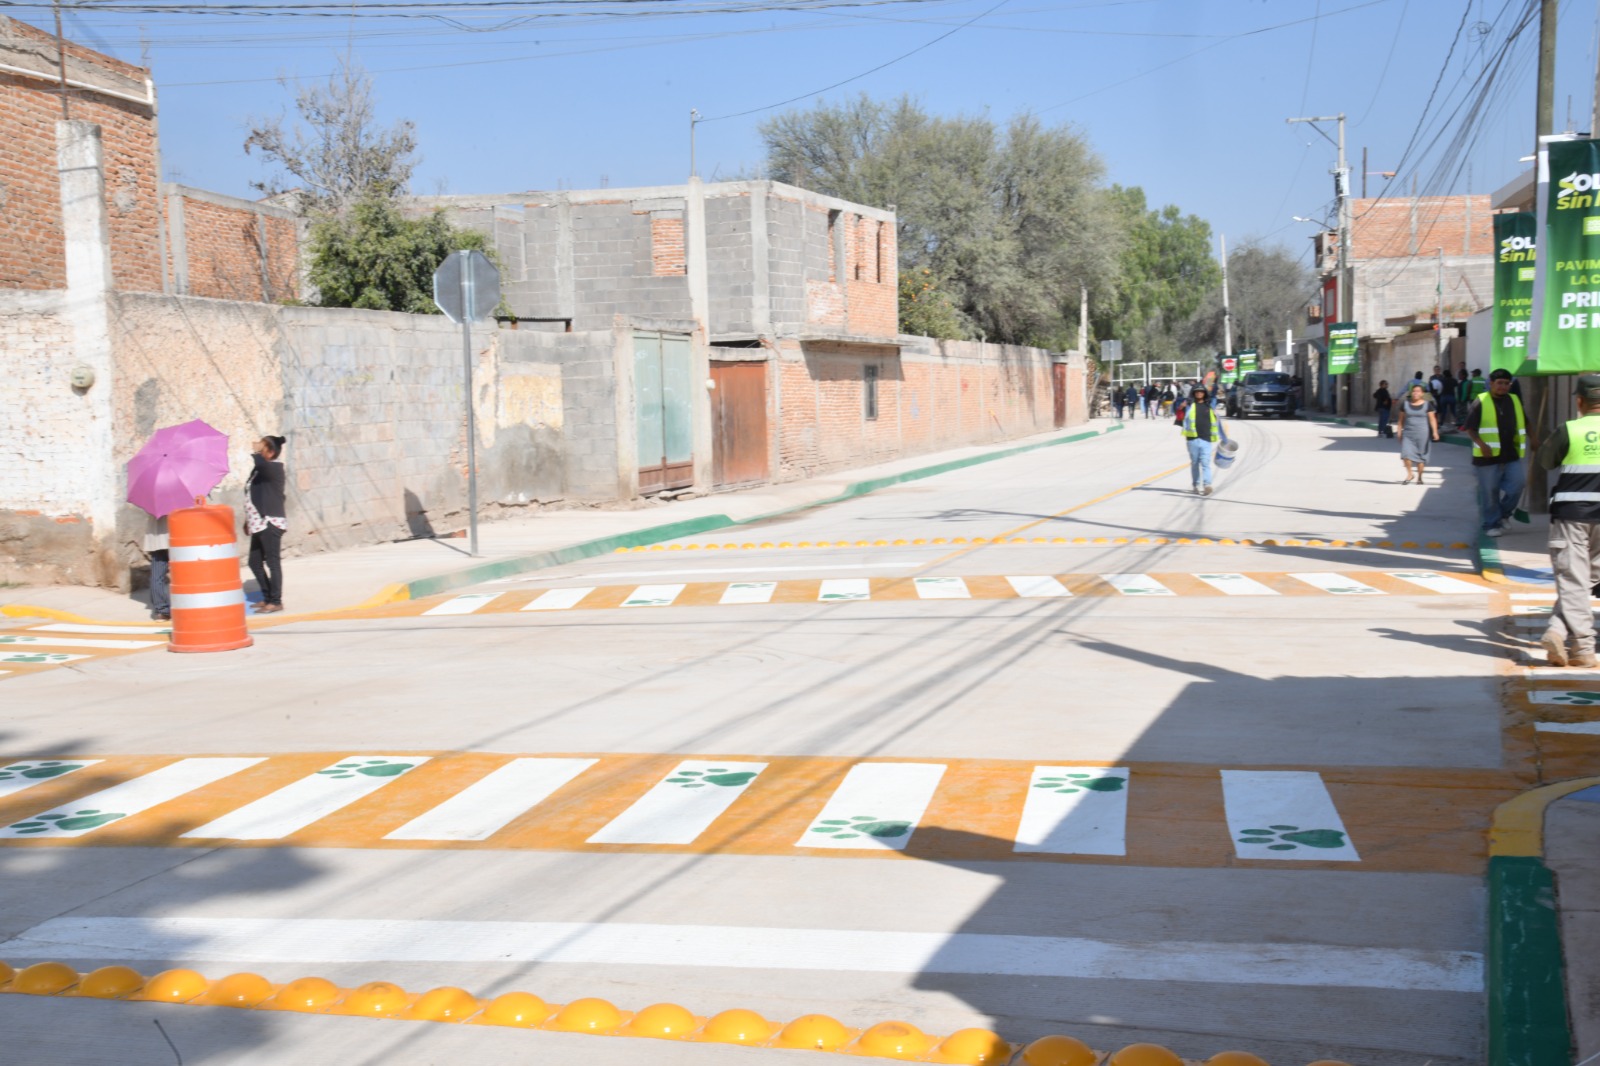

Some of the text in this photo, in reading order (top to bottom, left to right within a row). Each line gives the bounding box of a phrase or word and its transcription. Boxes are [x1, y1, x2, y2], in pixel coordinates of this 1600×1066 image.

[1557, 192, 1592, 209] sin
[1500, 251, 1526, 263] sin
[1570, 275, 1588, 285] LA
[1562, 292, 1600, 308] PRI
[1510, 309, 1524, 317] LA
[1558, 313, 1588, 329] DE
[1503, 337, 1525, 347] DE
[1585, 431, 1600, 443] G
